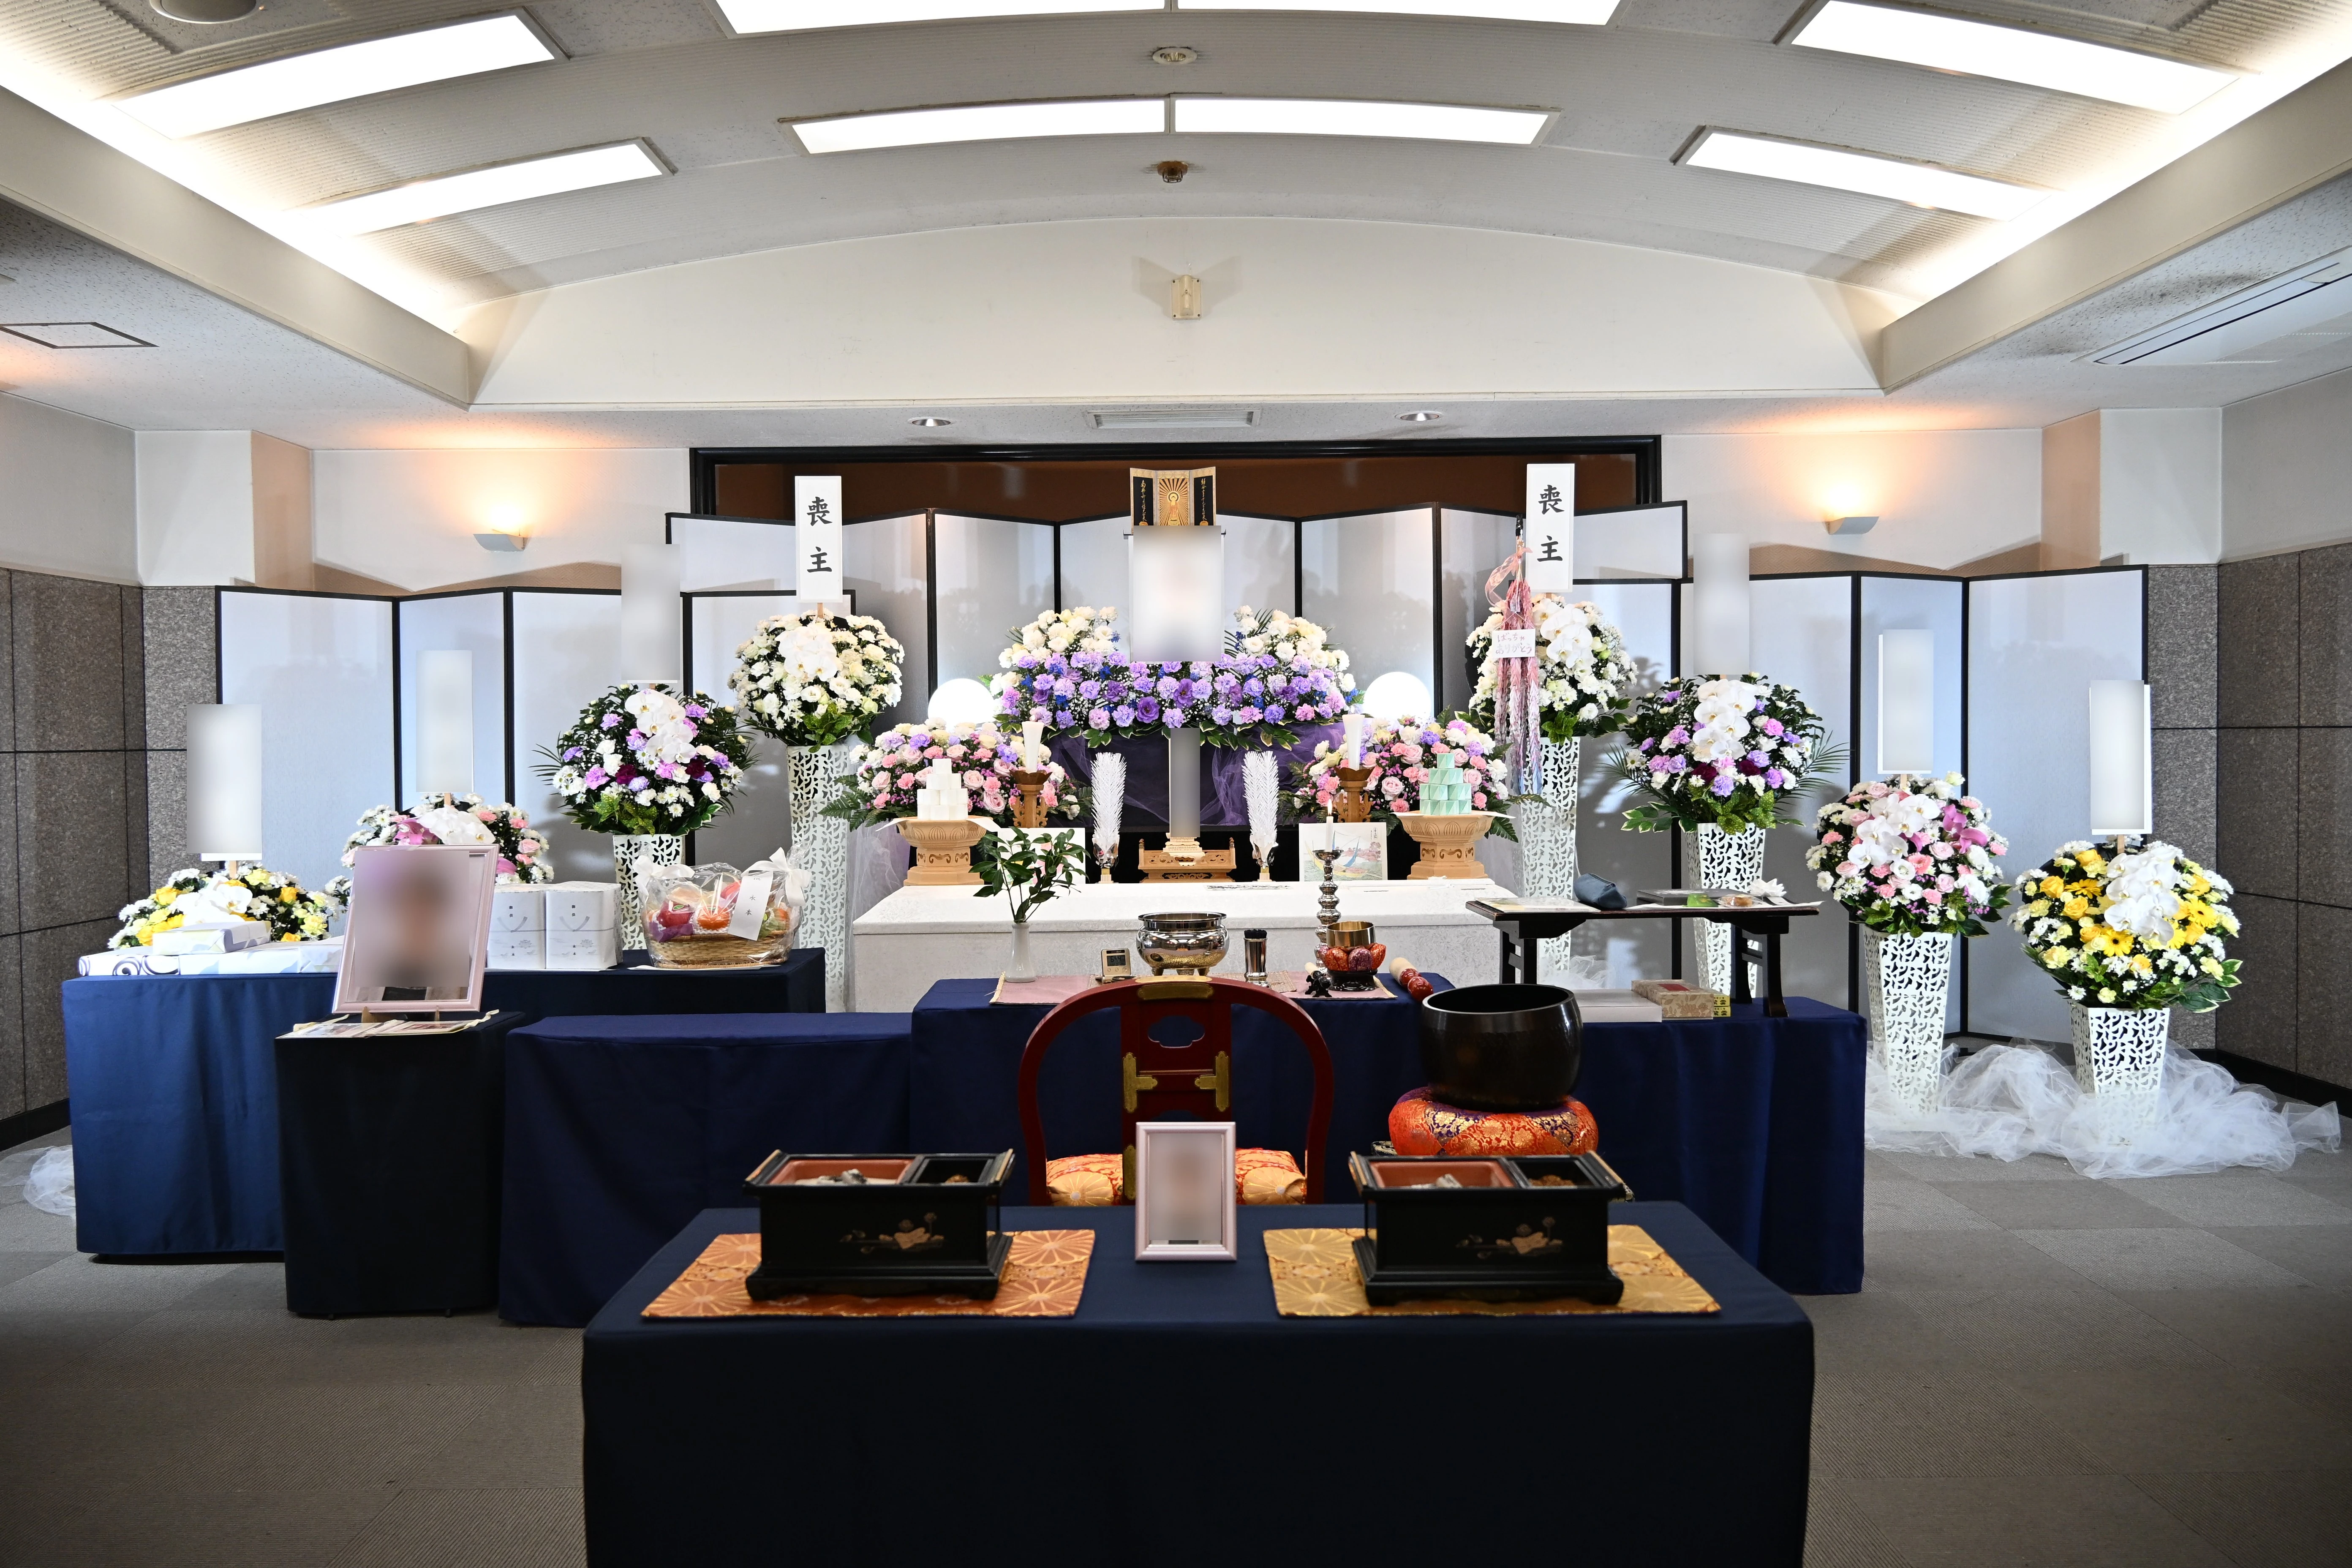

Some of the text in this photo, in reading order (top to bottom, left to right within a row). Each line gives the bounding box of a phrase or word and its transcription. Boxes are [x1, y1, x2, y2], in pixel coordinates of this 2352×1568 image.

[806, 496, 833, 573] 喪主
[1536, 485, 1565, 562] 喪主
[1495, 642, 1532, 654] ありがとう
